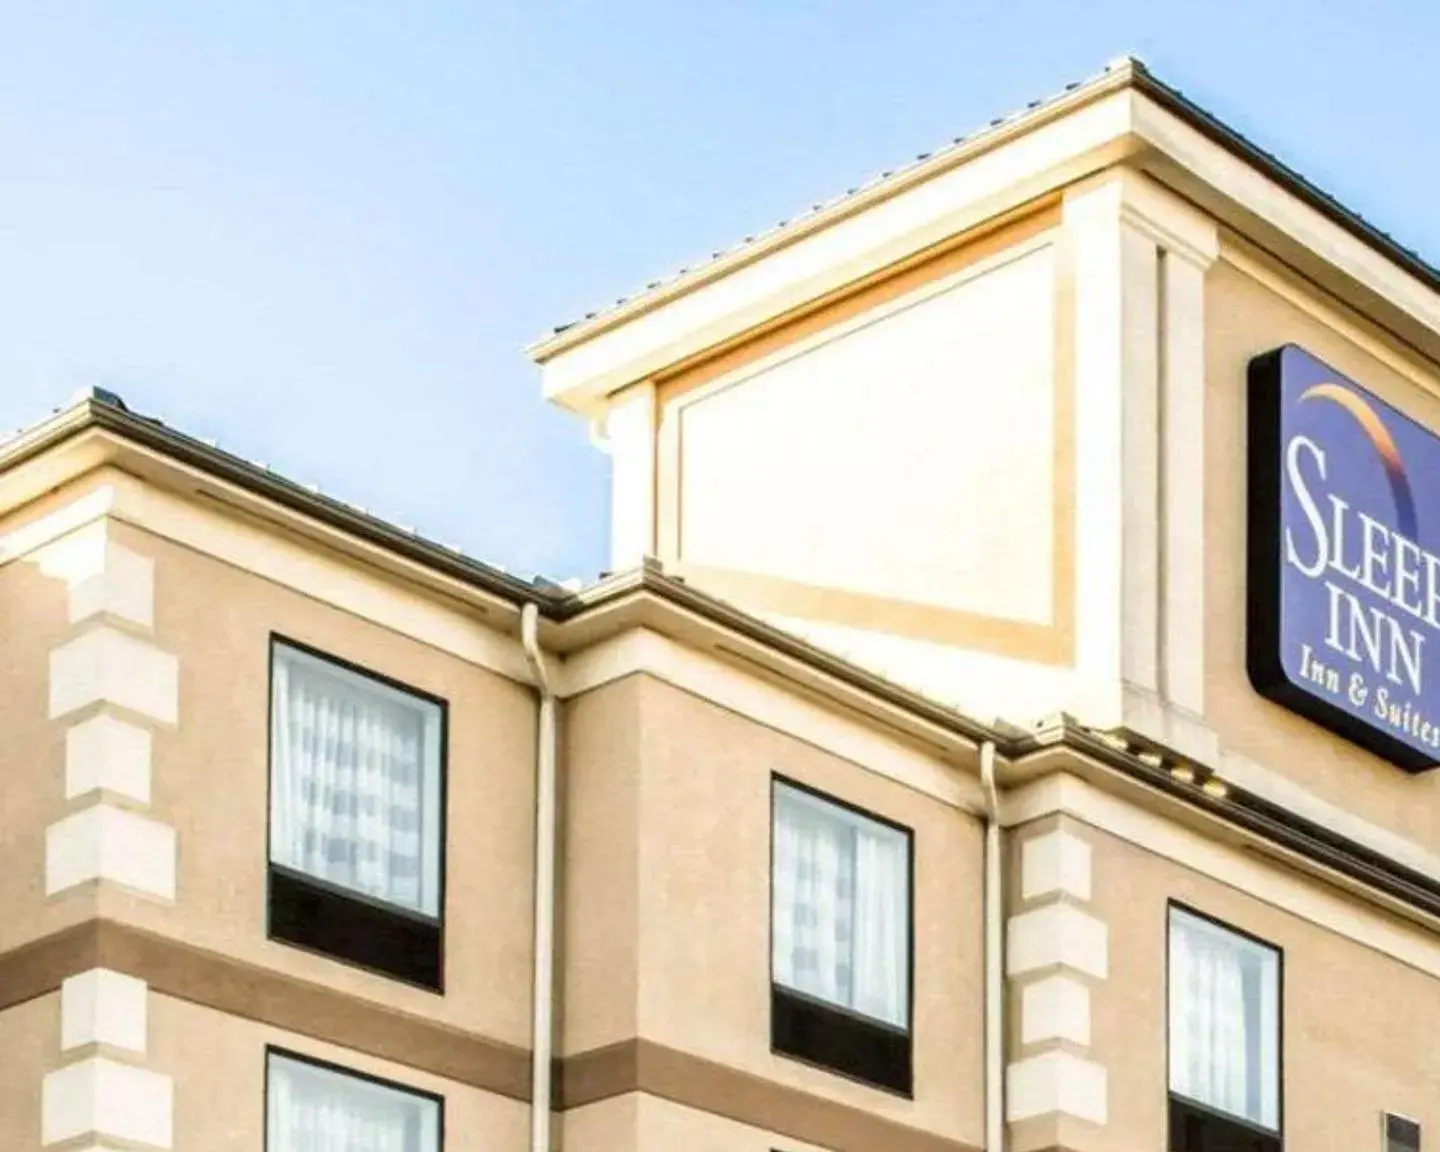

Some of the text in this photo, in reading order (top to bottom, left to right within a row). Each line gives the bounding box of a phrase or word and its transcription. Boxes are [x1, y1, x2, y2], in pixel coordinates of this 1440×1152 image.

[1298, 644, 1340, 694] Inn
[1348, 671, 1369, 707] &
[1324, 580, 1425, 696] INN
